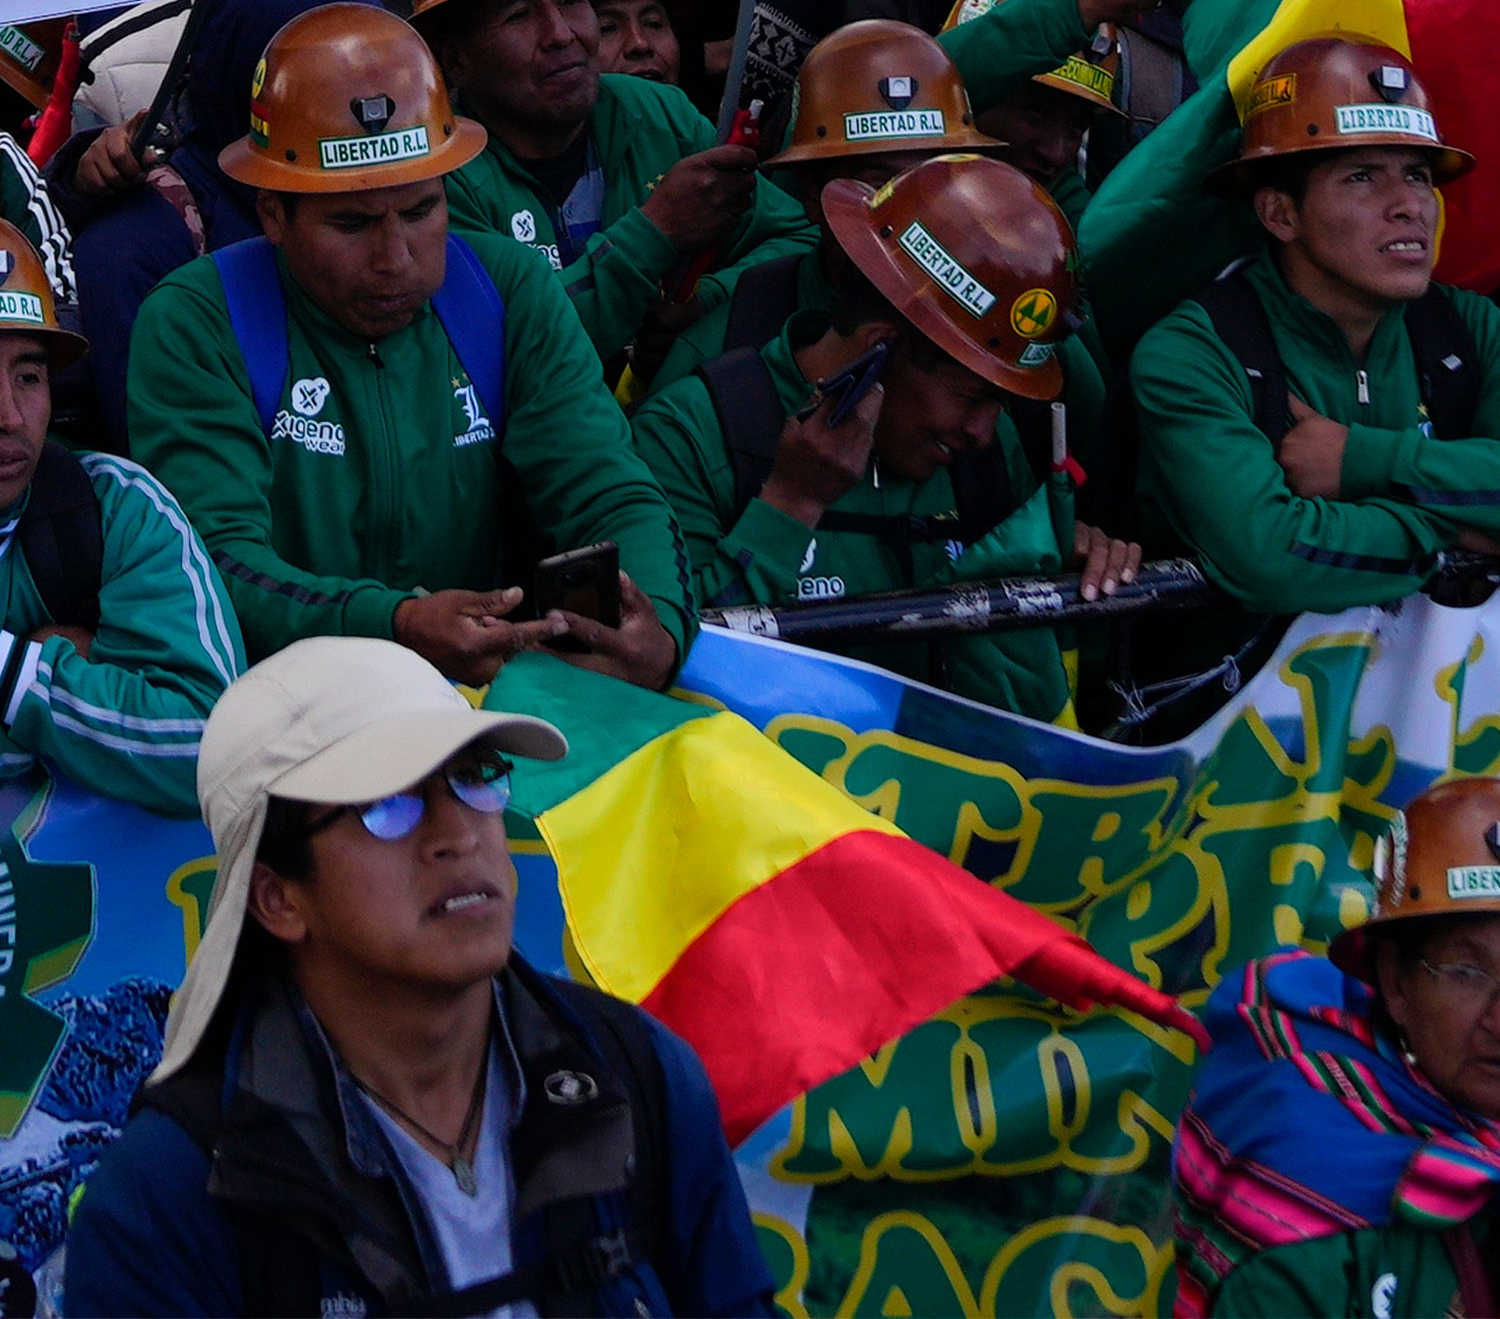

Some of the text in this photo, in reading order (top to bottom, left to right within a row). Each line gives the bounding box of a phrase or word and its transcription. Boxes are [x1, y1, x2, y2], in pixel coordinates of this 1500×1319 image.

[848, 113, 943, 136] LIBERTAD R.L.
[1340, 107, 1413, 131] LIBERTAD
[322, 134, 427, 166] LIBERTAD R.L.
[902, 221, 969, 291] LIBERTAD
[20, 293, 41, 318] R.L.
